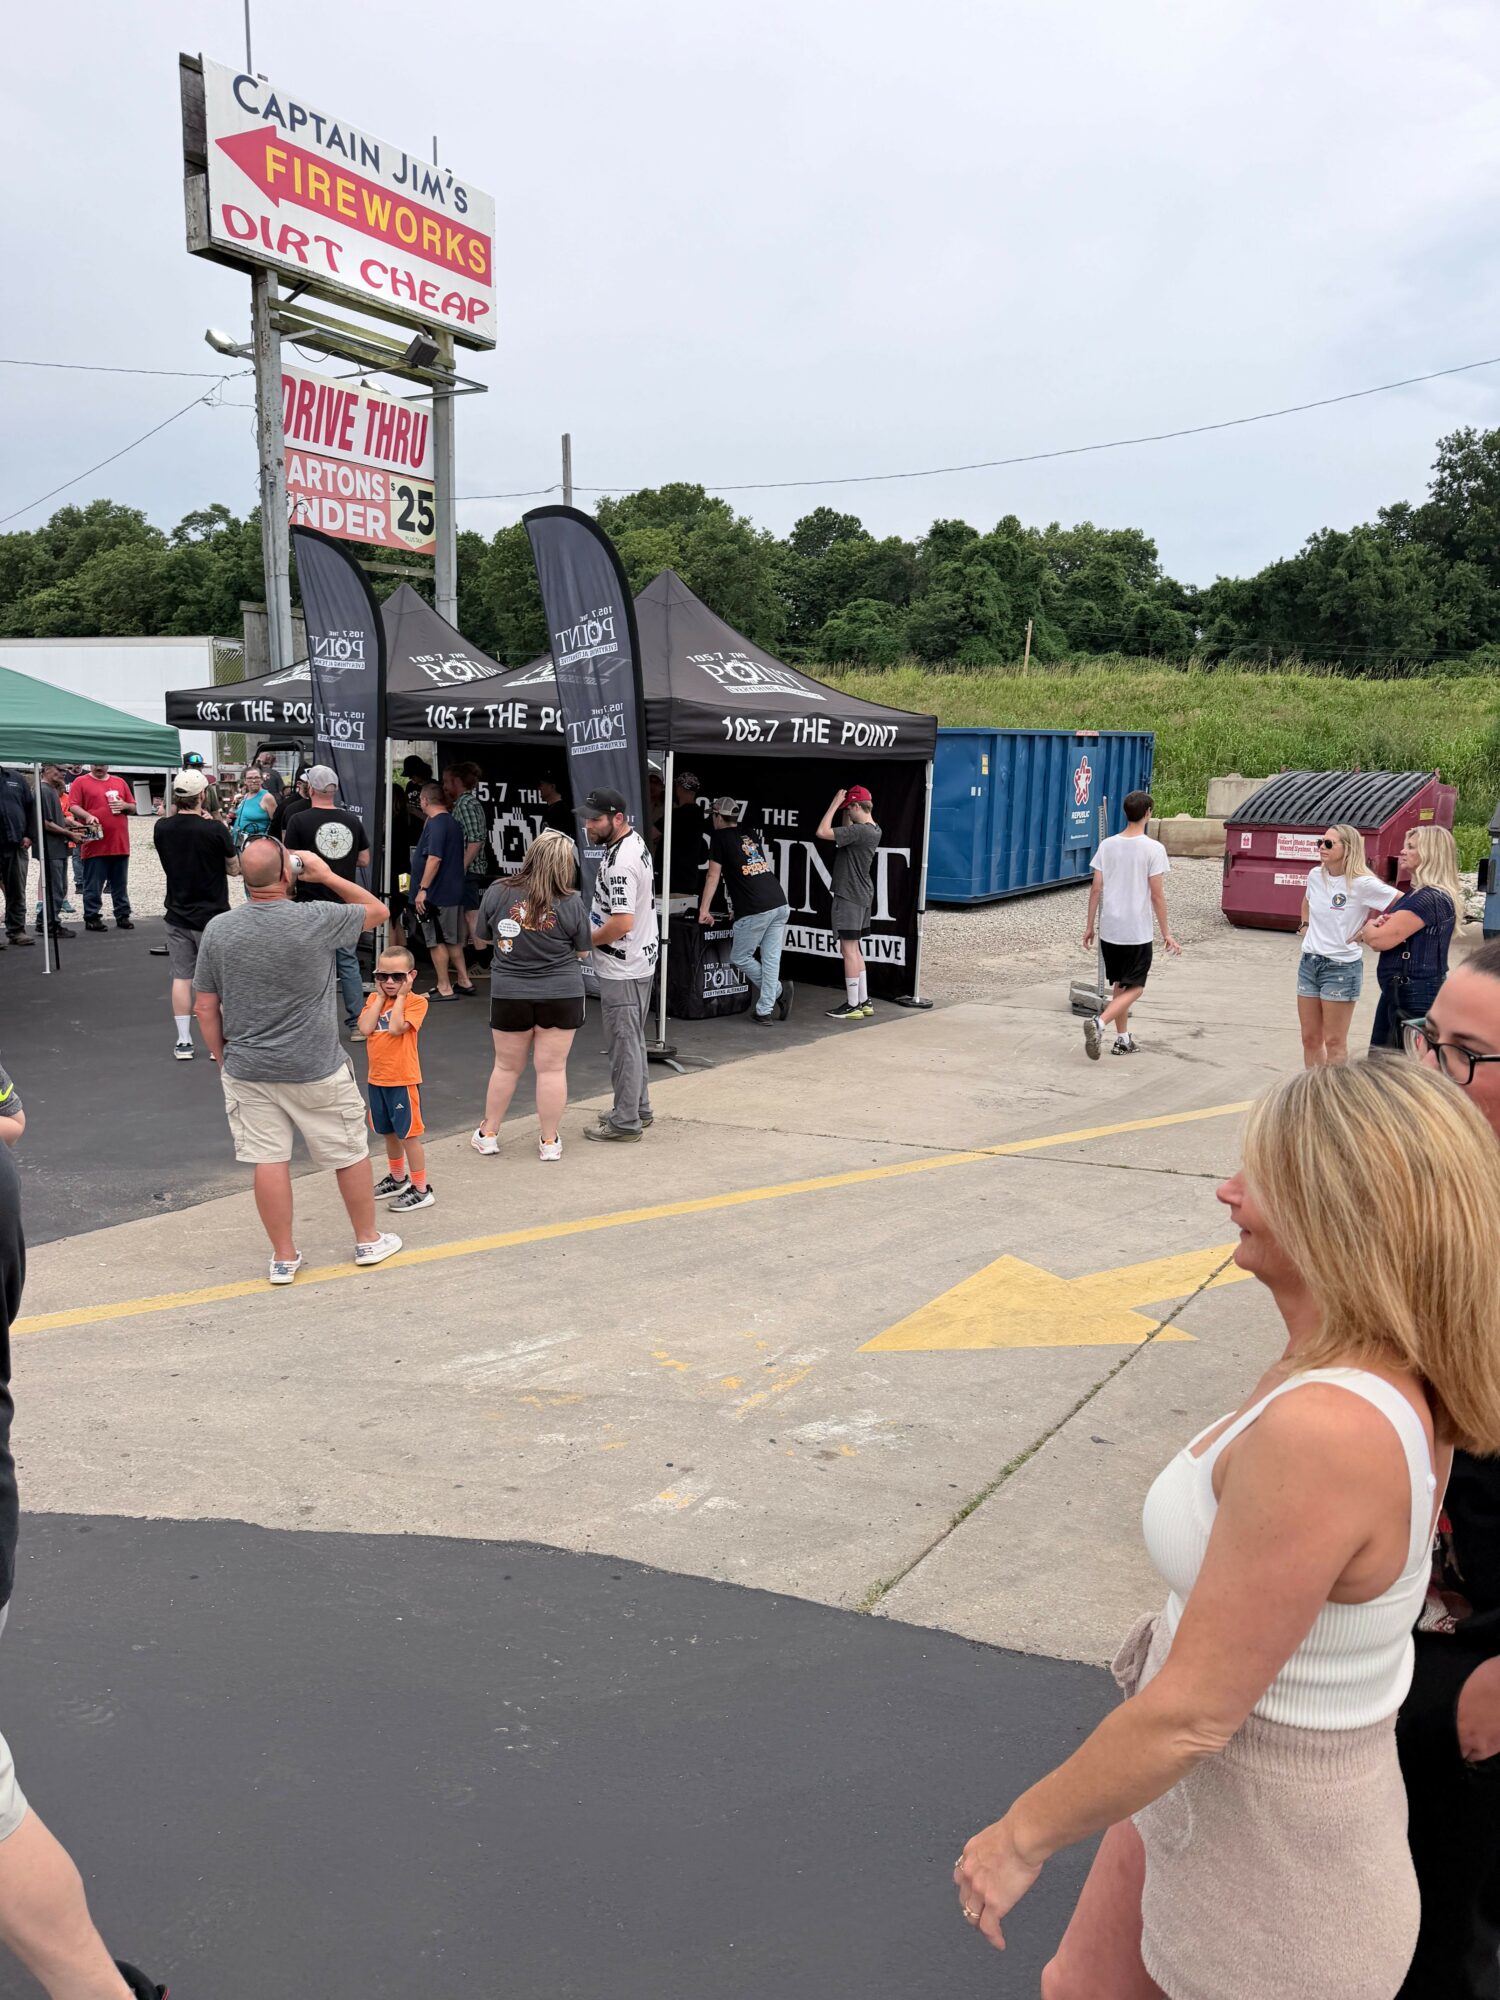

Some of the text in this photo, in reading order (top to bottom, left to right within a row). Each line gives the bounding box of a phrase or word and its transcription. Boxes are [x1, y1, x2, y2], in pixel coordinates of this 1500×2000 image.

[232, 74, 468, 214] CAPTAIN JIM'S
[265, 144, 486, 274] FIREWORKS
[221, 203, 490, 324] DIRT CHEAP
[281, 373, 428, 469] DRIVE THRU
[285, 455, 385, 504] ARTONS
[409, 653, 444, 663] 105.7
[686, 652, 749, 663] 105.7 THE
[697, 659, 810, 692] POINT
[196, 700, 235, 722] 105.7
[241, 700, 275, 722] THE
[425, 704, 475, 729] 105.7
[484, 702, 528, 729] THE
[722, 716, 899, 748] 105.7 THE POINT
[761, 808, 799, 827] THE
[785, 929, 902, 961] ALTERTIVE
